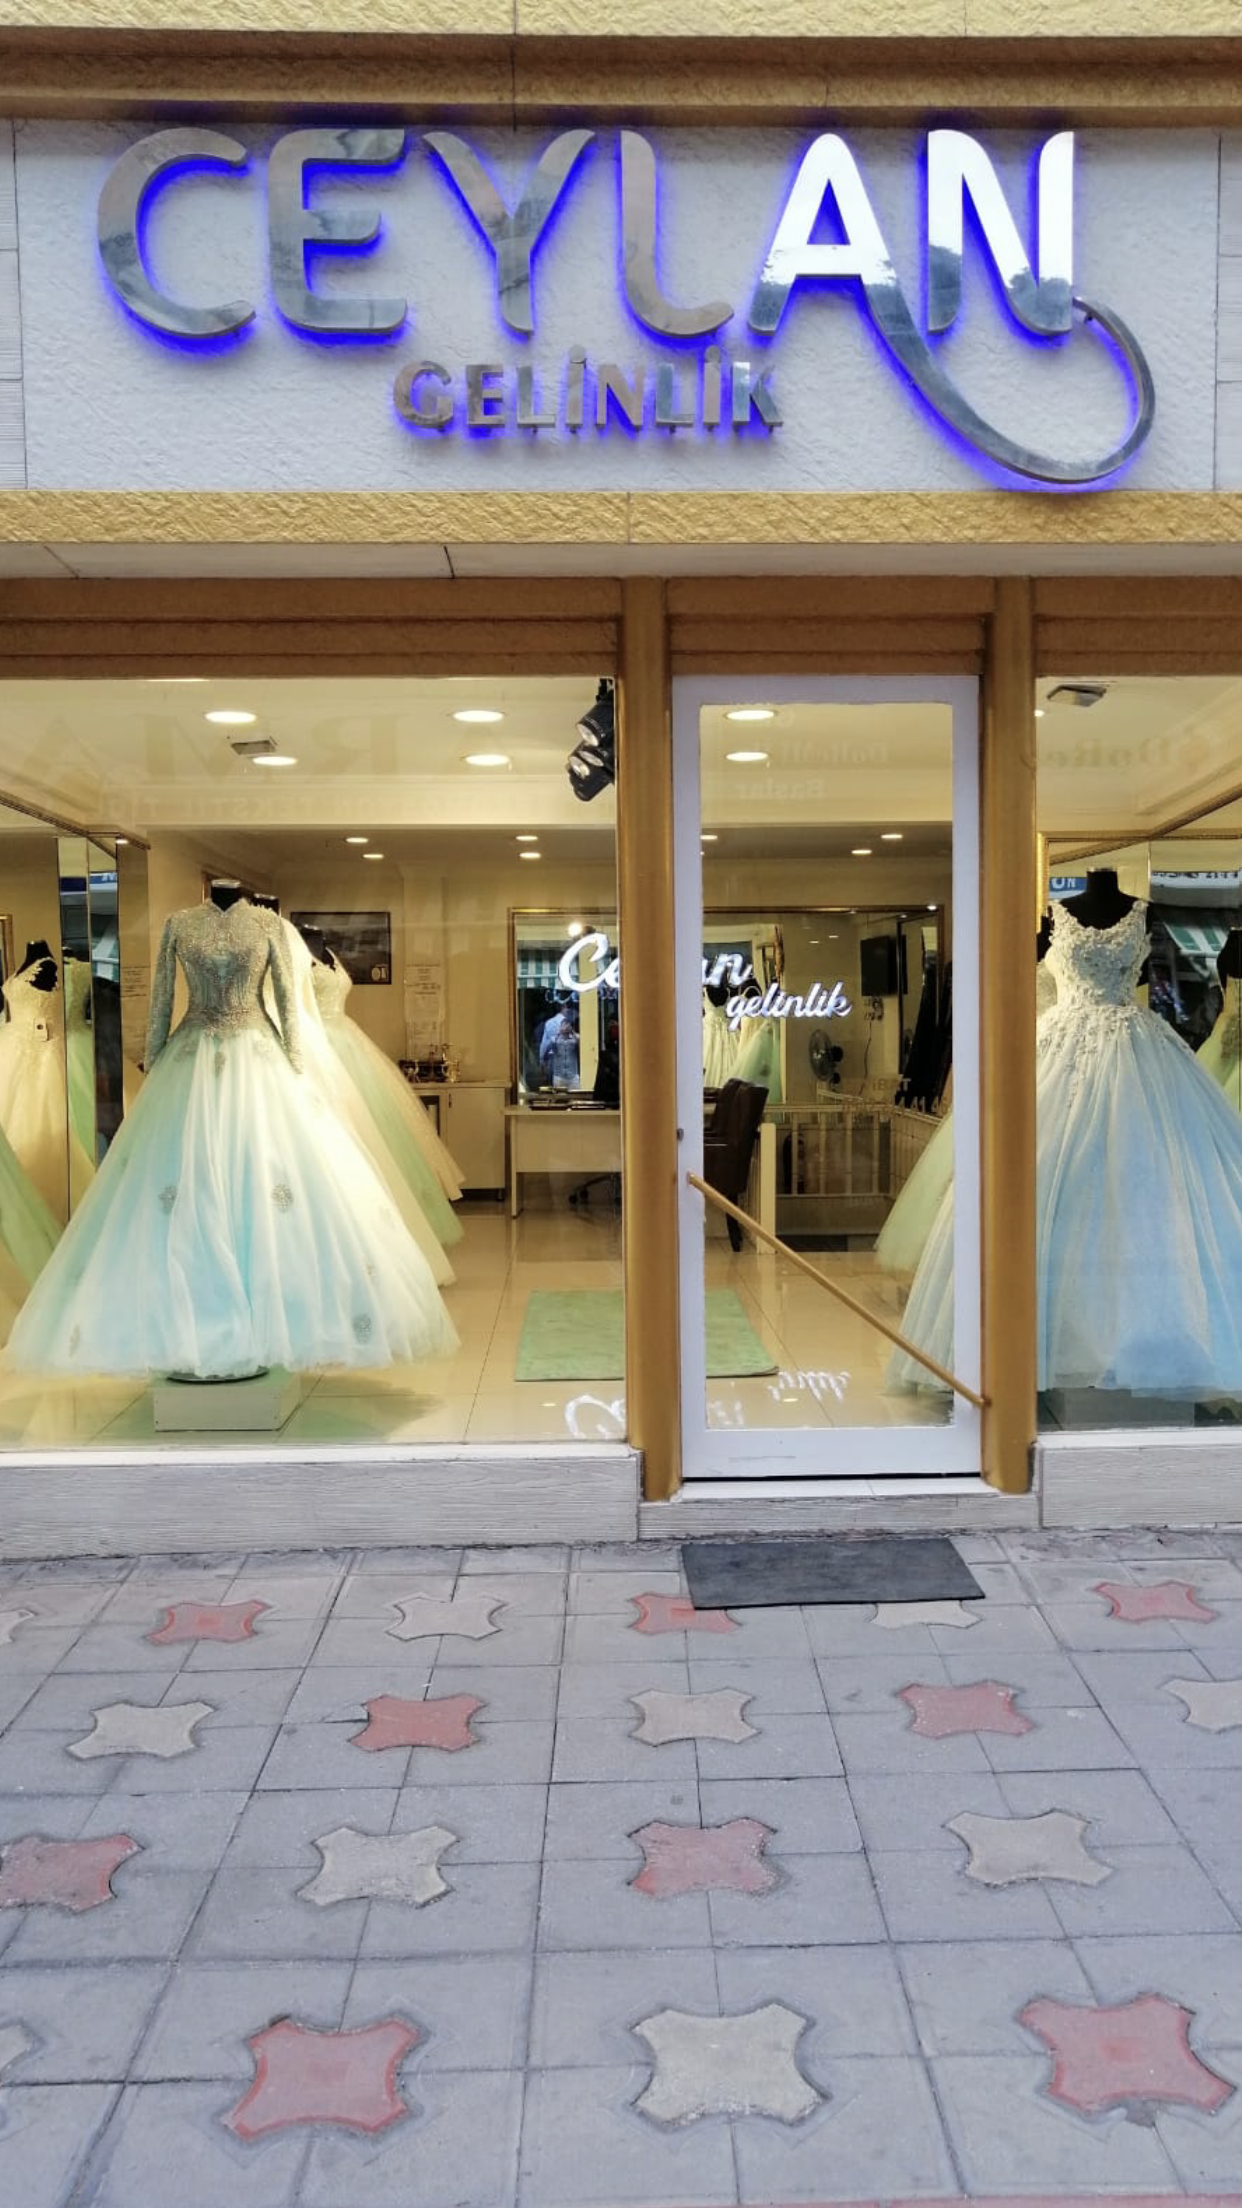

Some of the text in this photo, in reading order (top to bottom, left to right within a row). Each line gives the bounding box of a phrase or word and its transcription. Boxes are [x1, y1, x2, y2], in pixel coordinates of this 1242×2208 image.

[95, 126, 1156, 484] CEYLAN
[393, 344, 783, 430] GELİNLİK
[725, 980, 852, 1031] gelinlik
